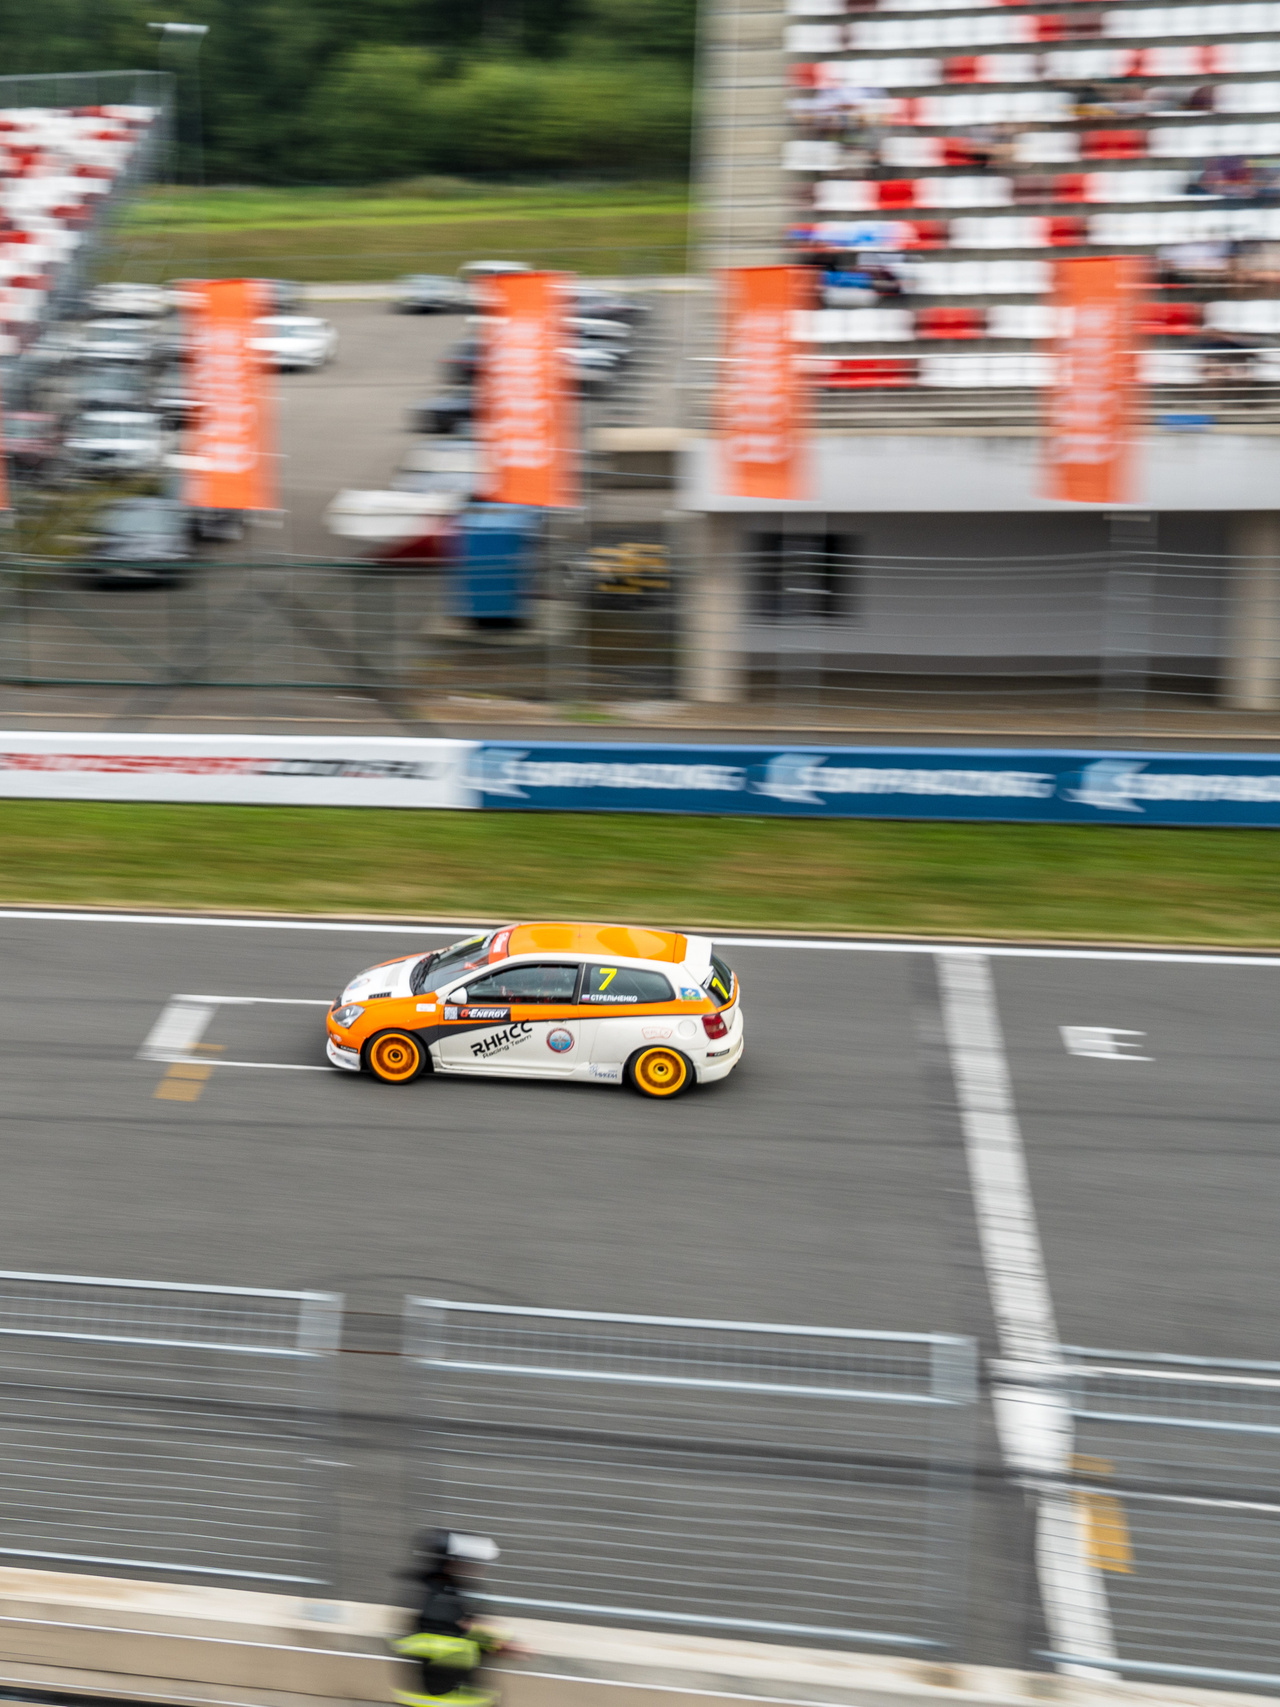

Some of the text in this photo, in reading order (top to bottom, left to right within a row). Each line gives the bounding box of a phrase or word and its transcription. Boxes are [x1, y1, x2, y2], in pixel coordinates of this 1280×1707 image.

[598, 967, 618, 991] 7
[711, 977, 729, 999] 7
[590, 994, 638, 1002] СТРЕЛЬЧЕНКО
[470, 1018, 533, 1057] RHHCC
[482, 1034, 532, 1059] Racing Team
